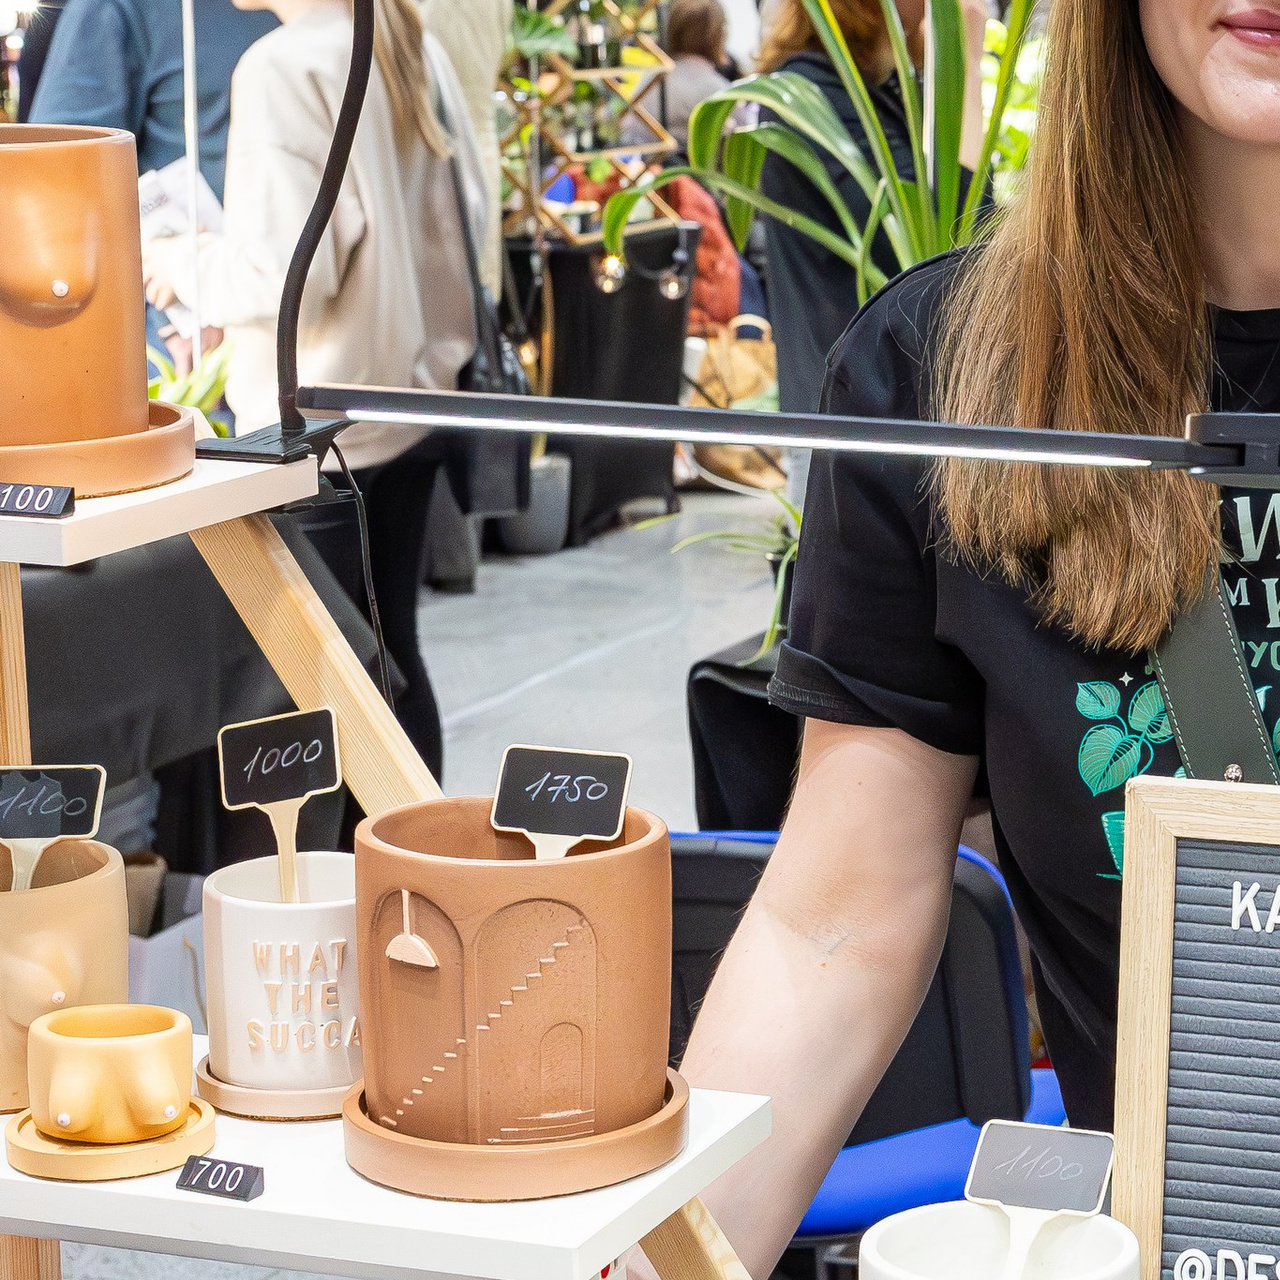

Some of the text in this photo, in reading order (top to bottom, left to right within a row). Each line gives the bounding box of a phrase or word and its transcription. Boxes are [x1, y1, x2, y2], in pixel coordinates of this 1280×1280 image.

[243, 738, 323, 783] 1000
[525, 771, 610, 803] 1750
[252, 938, 349, 975] WHAT
[263, 977, 341, 1016] THE
[246, 1016, 362, 1054] SUCCA
[190, 1160, 245, 1192] 700
[990, 1145, 1084, 1181] 1100
